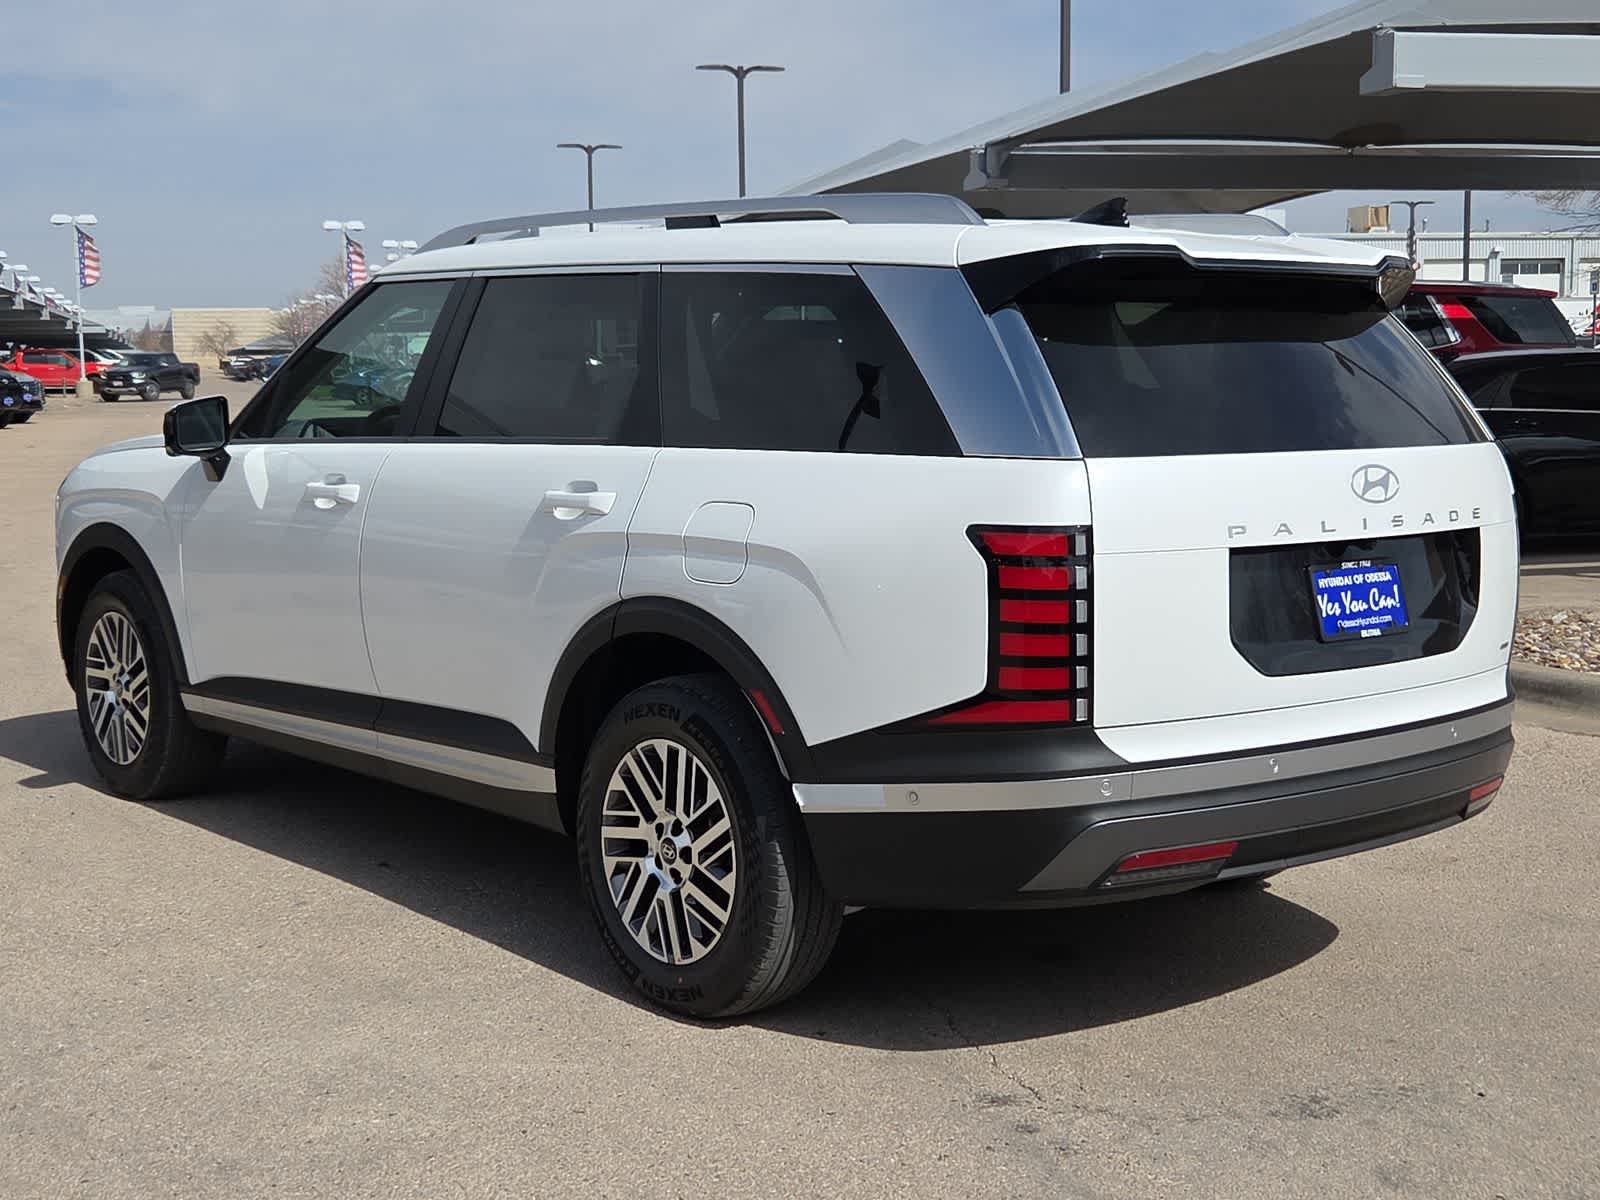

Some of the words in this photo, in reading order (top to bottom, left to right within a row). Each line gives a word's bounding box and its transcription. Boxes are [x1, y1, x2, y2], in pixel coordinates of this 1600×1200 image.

[1227, 506, 1481, 539] PALISADE
[1318, 576, 1353, 589] HYUNDAI
[1353, 574, 1364, 585] OF
[1364, 571, 1392, 583] ODESSA
[1317, 593, 1341, 618] Yes
[1341, 590, 1368, 614] You
[1369, 584, 1400, 611] Can!
[623, 702, 681, 724] NEXEN
